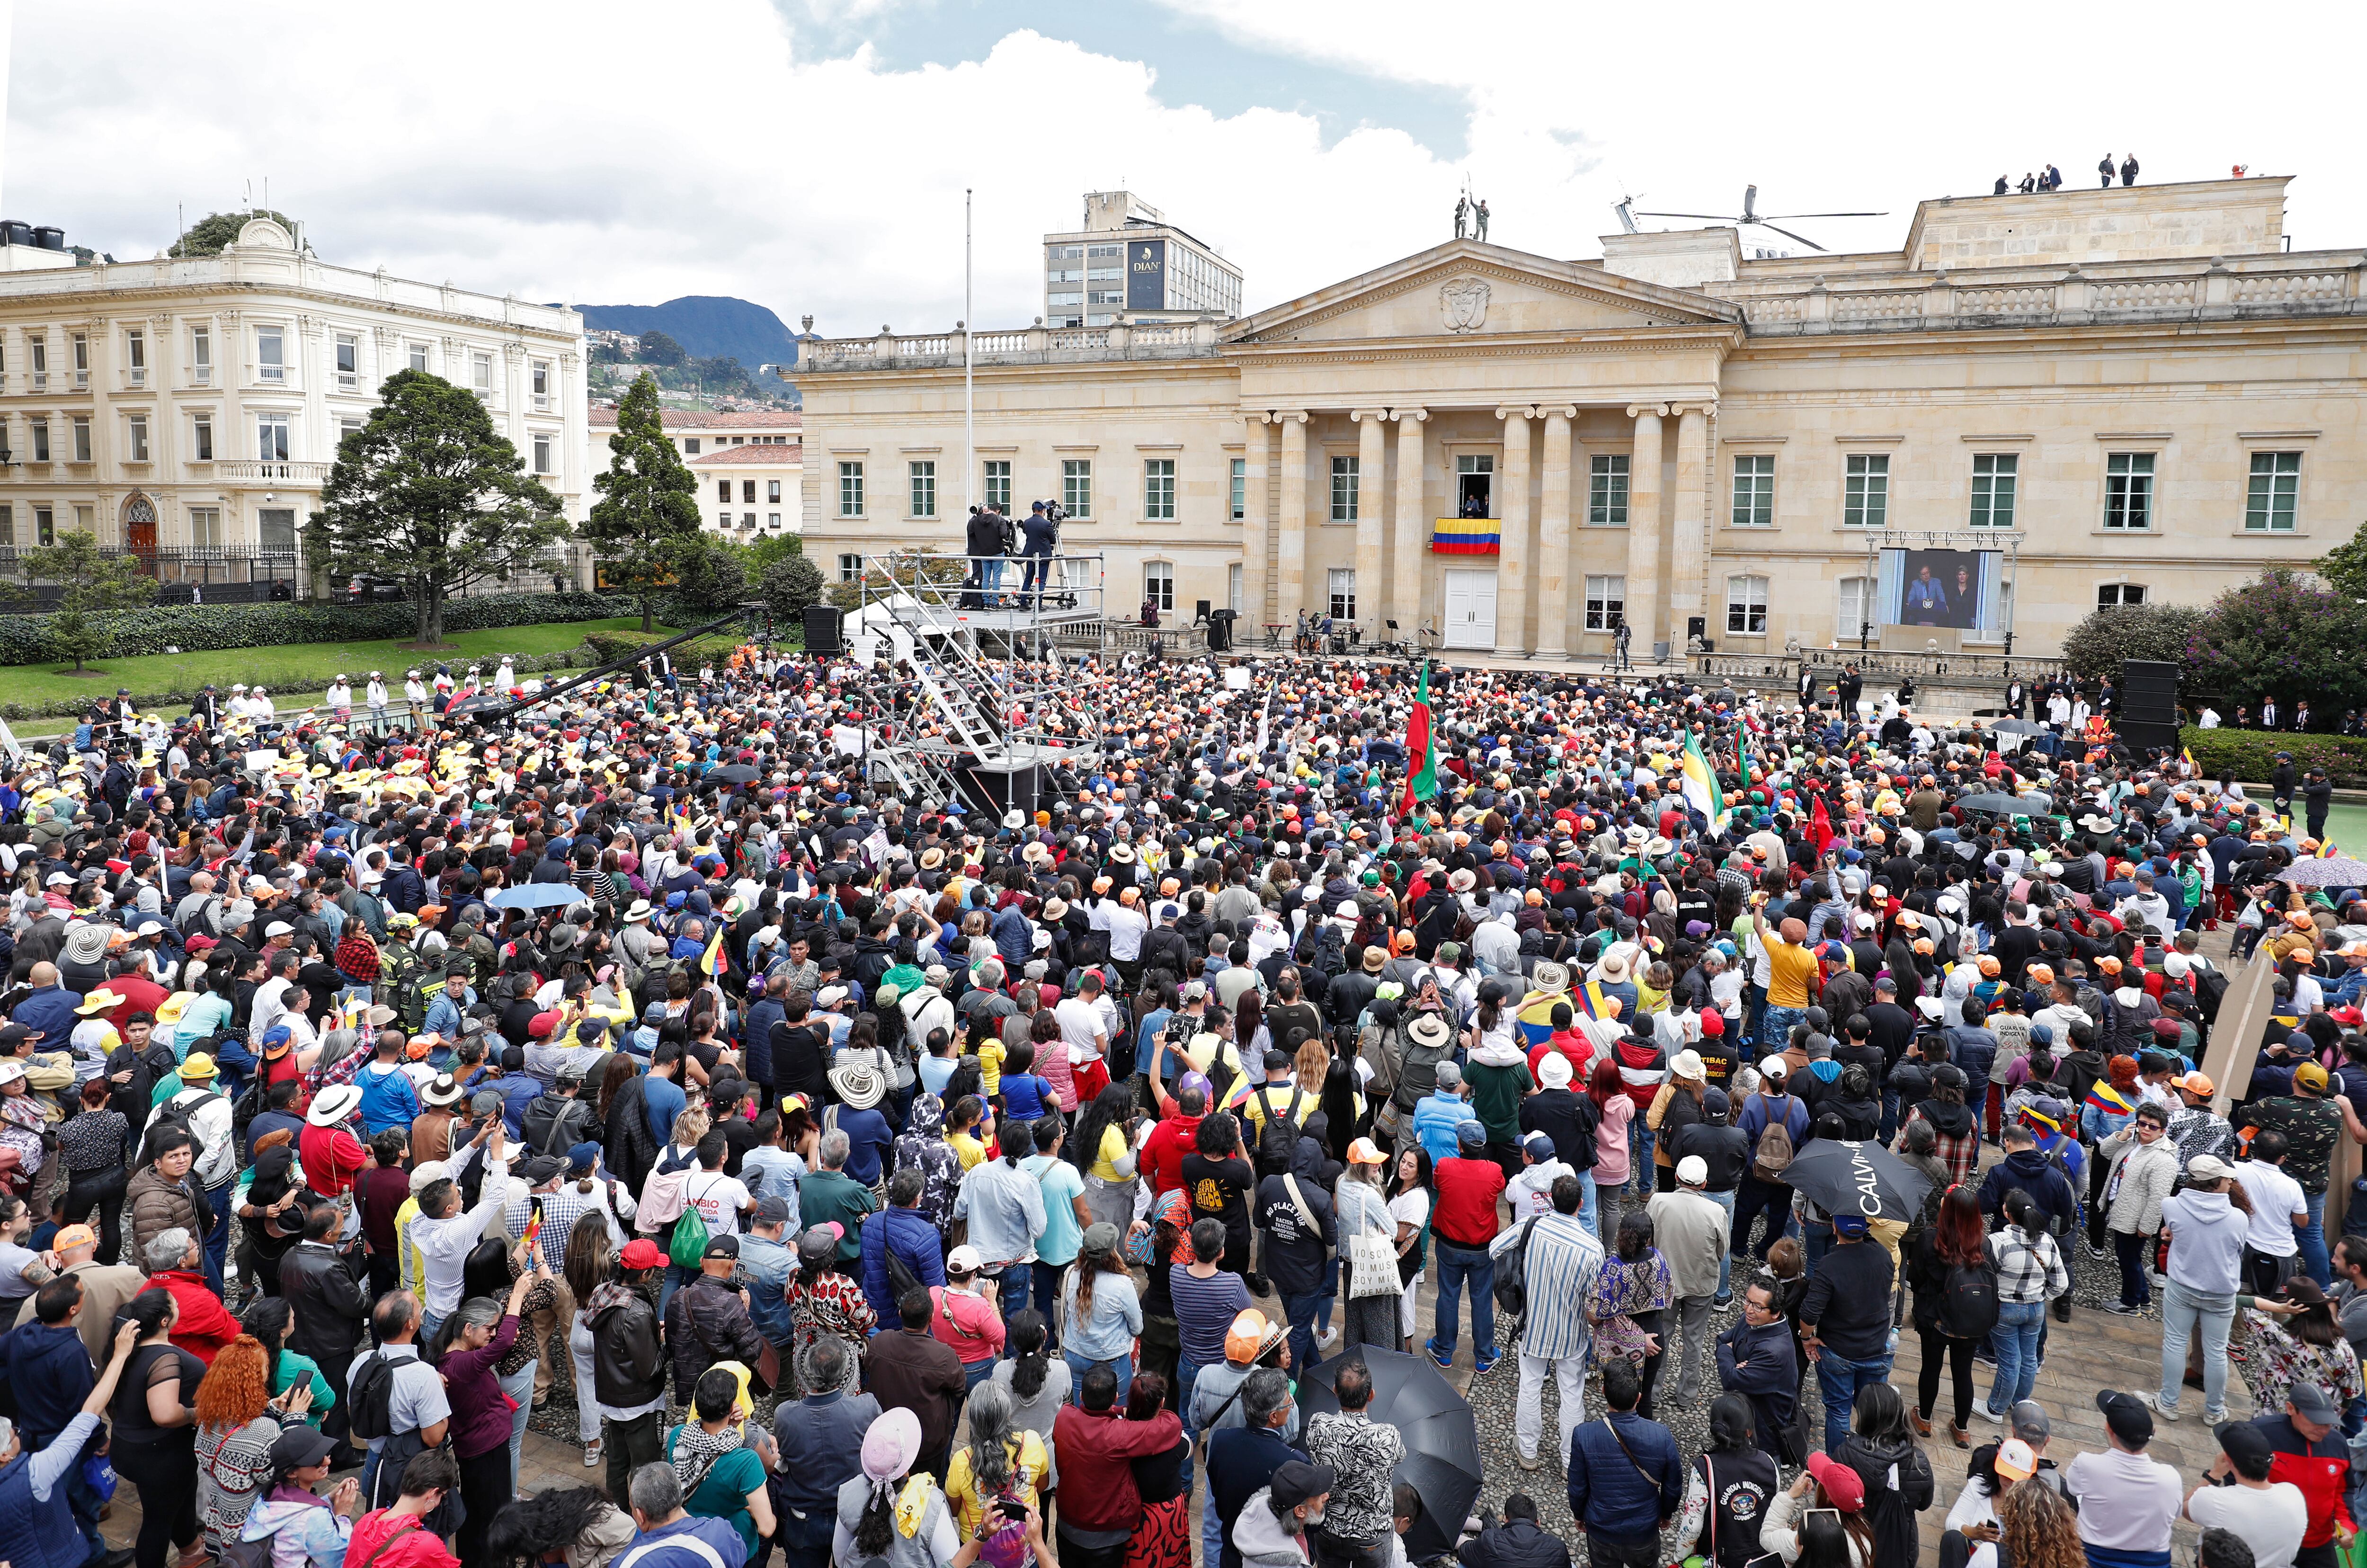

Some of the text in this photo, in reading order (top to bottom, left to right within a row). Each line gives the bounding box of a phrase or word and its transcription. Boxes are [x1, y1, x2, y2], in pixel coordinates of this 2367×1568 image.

[1134, 261, 1158, 271] DIAN
[6, 1066, 16, 1075] B
[1266, 1202, 1306, 1227] NO PLACE FOR
[1275, 1216, 1293, 1226] RACISM
[1271, 1226, 1301, 1238] HOMOPHOBIA
[1275, 1222, 1295, 1232] FASCISM
[1277, 1232, 1295, 1241] SEXISM
[1369, 1247, 1387, 1260] SOY
[1353, 1262, 1365, 1271] TU
[1353, 1273, 1396, 1285] SOY MIS
[1353, 1285, 1397, 1297] POEMAS
[1720, 1481, 1766, 1505] GUARDIA INDIGENA
